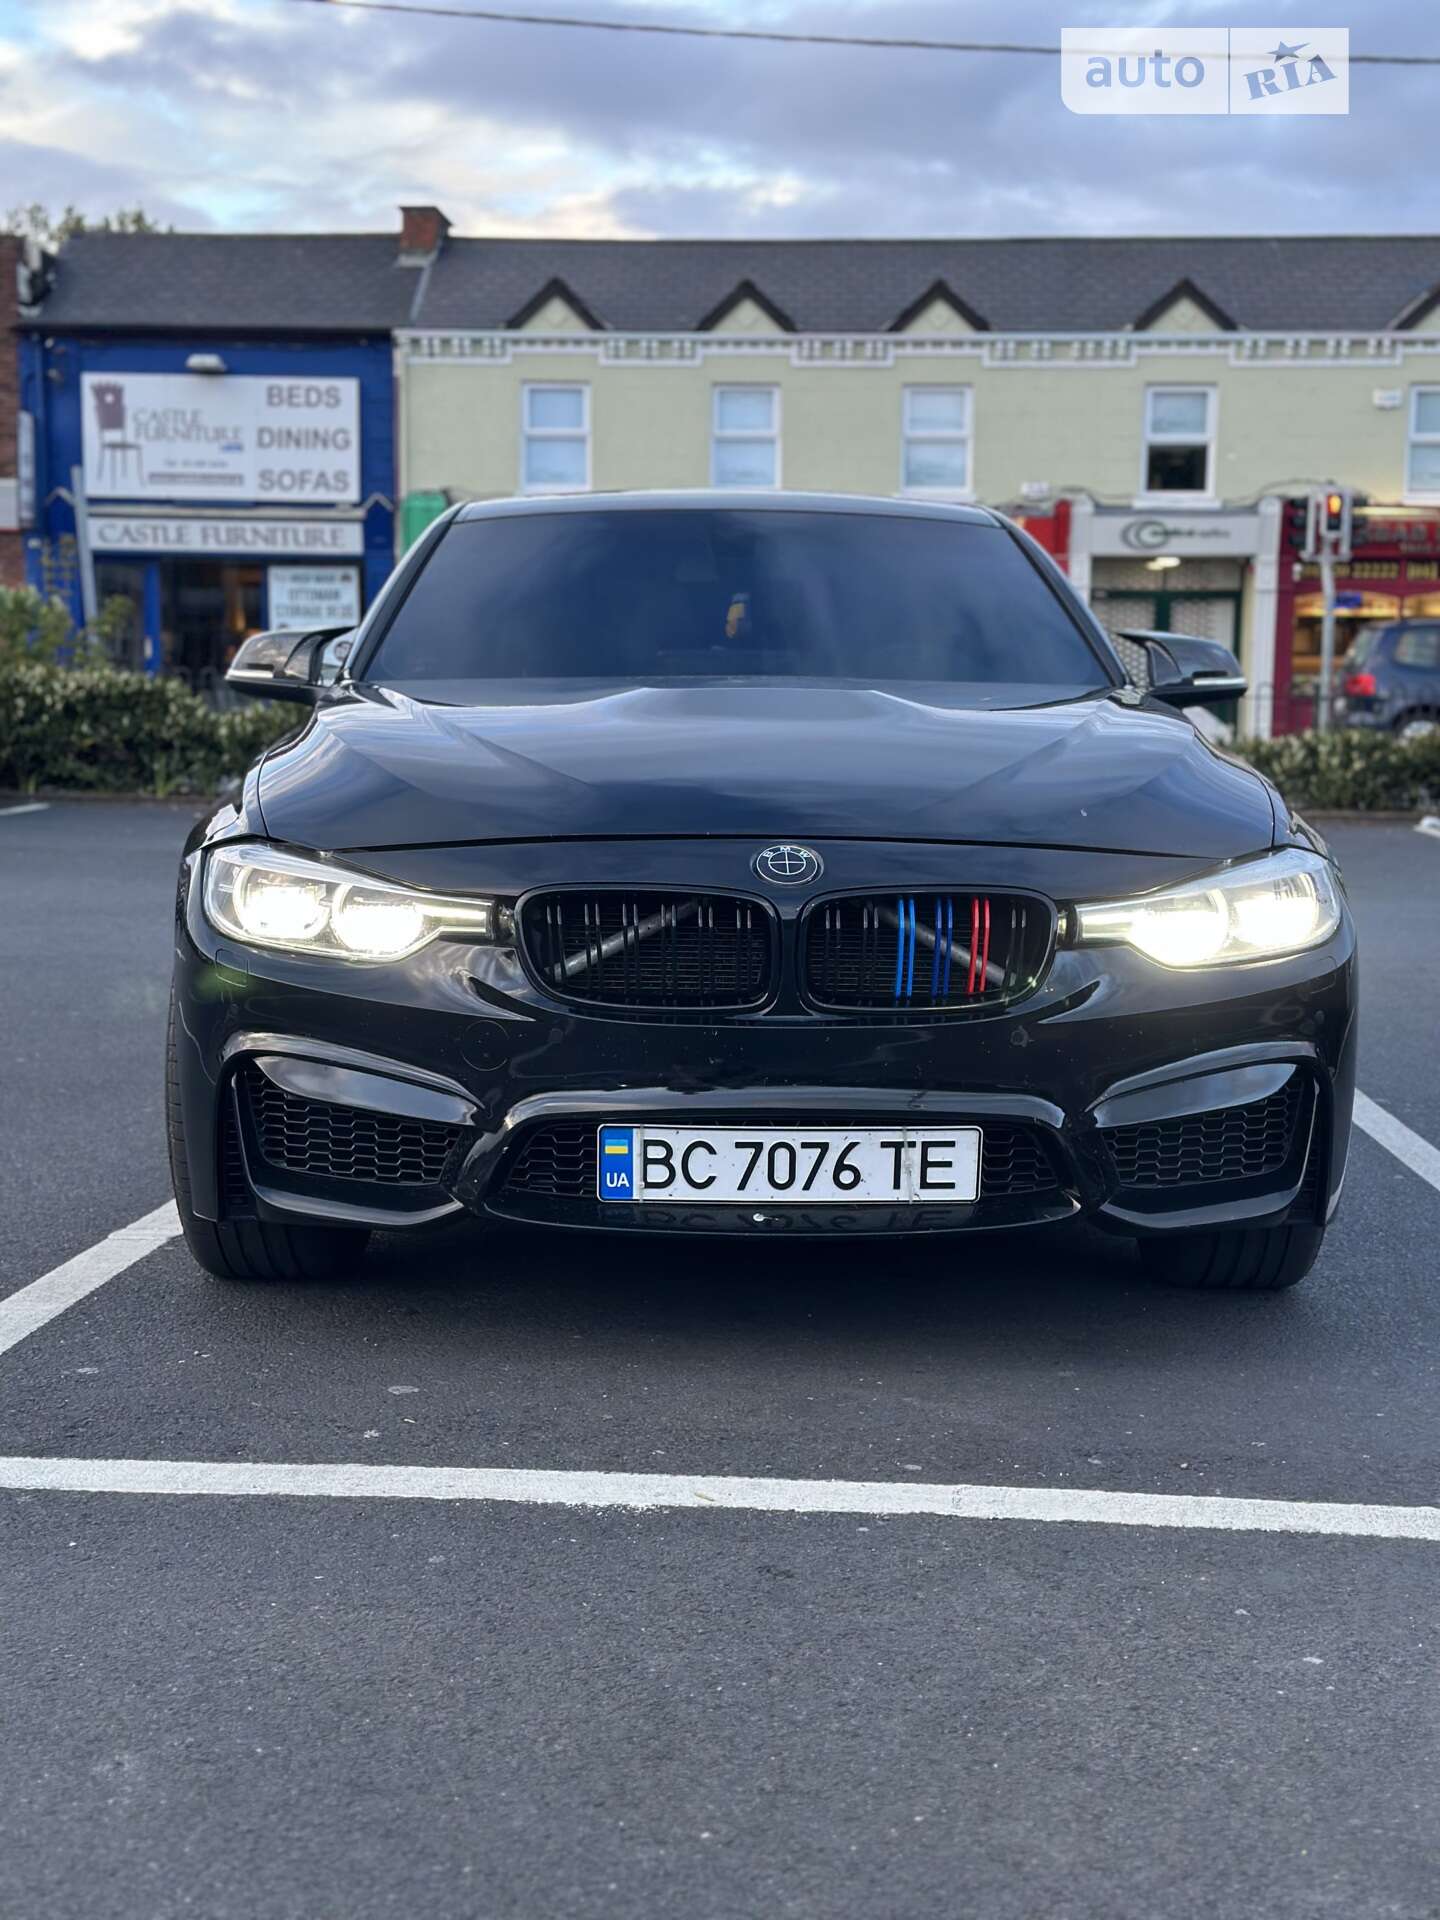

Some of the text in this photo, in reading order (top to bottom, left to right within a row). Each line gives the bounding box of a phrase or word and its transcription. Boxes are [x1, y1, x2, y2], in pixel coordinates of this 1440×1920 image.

[266, 384, 341, 410] BEDS
[256, 426, 351, 451] DINING
[258, 468, 350, 493] SOFAS
[98, 522, 345, 549] CASTLE FURNITURE
[641, 1139, 957, 1191] BC 7076 TE
[606, 1172, 630, 1188] UA
